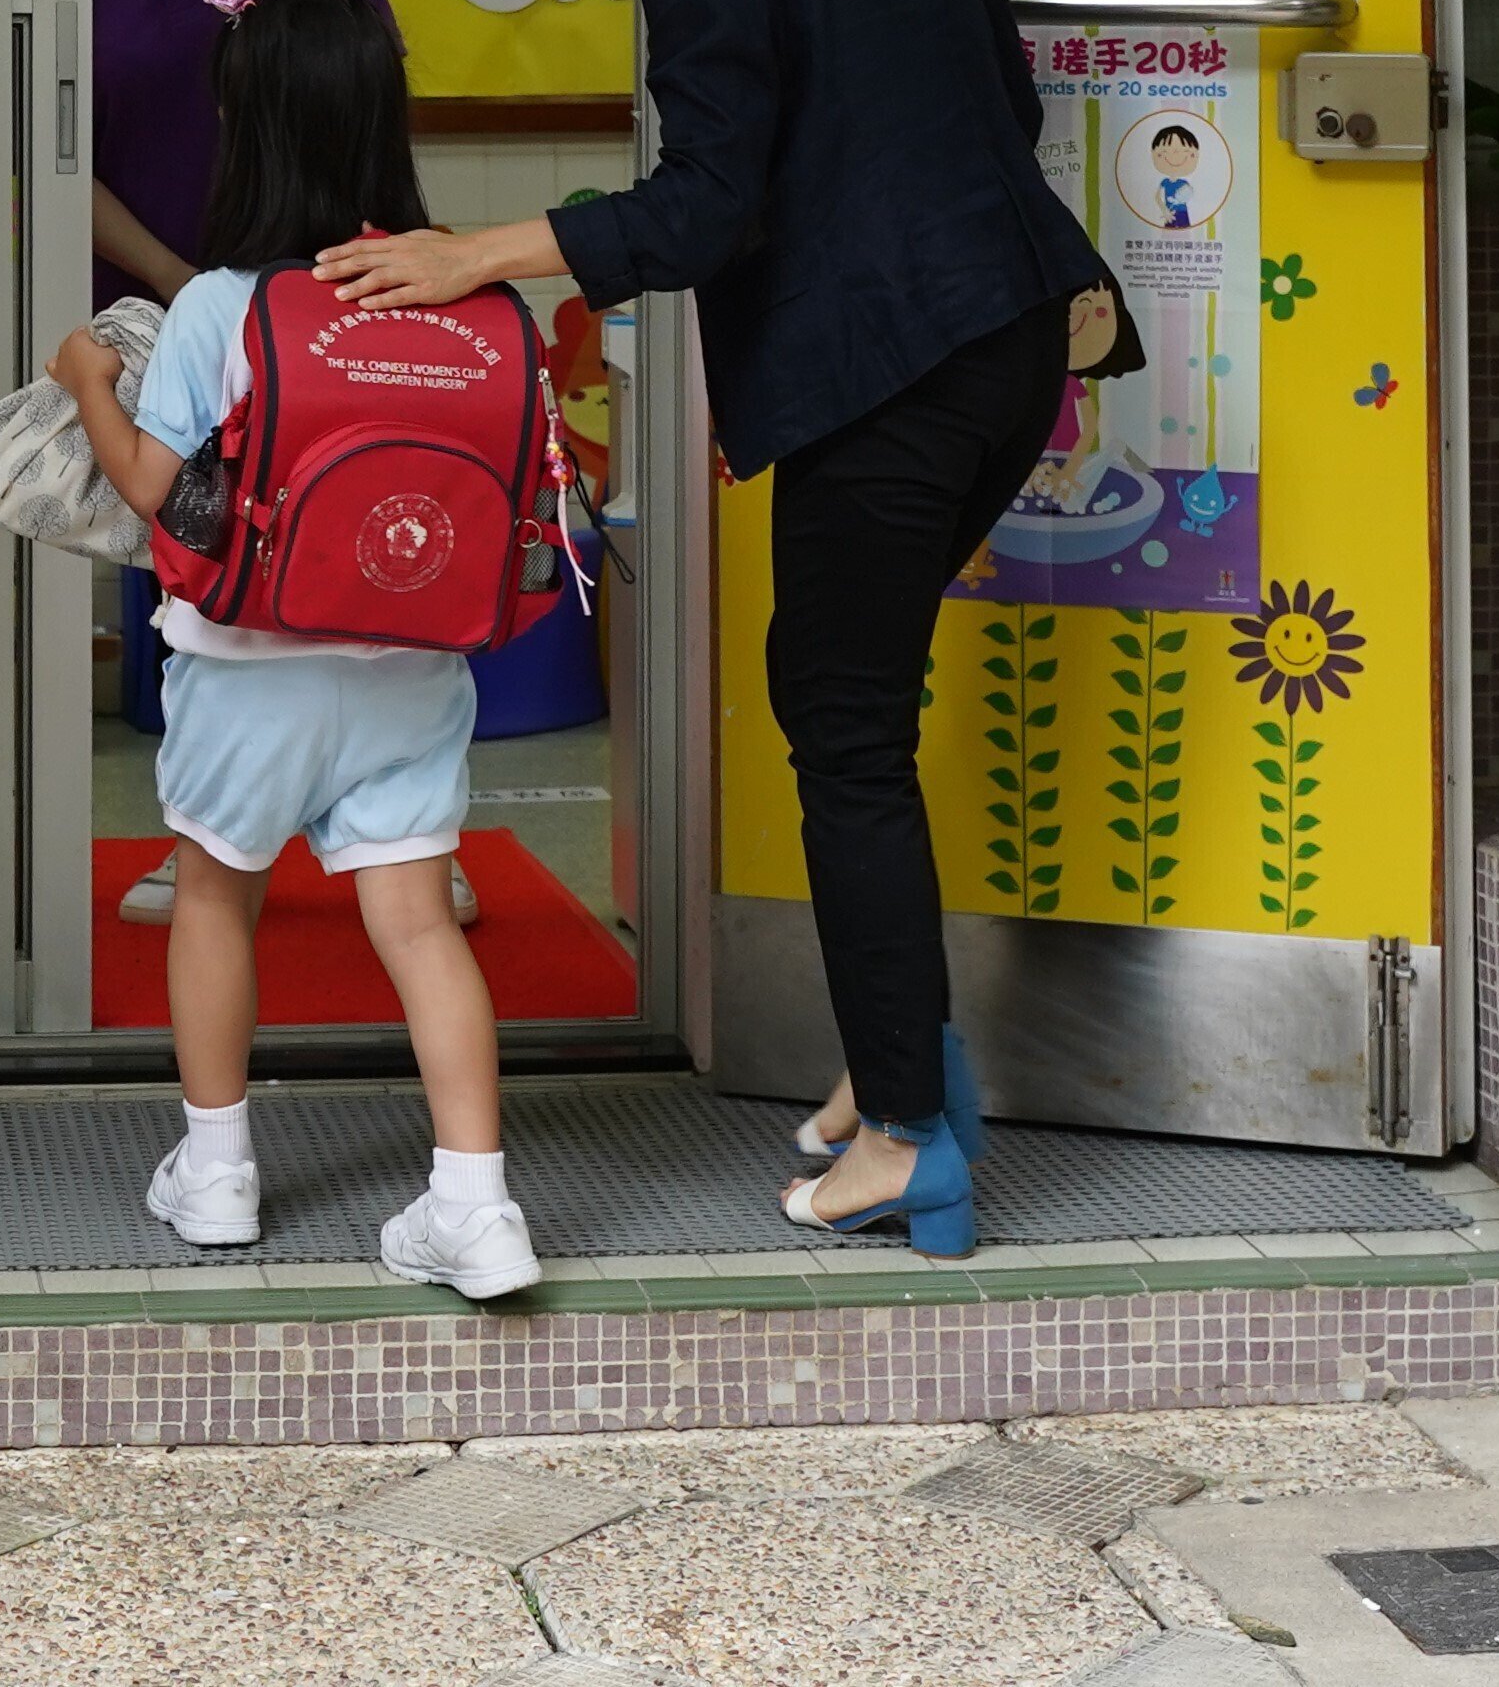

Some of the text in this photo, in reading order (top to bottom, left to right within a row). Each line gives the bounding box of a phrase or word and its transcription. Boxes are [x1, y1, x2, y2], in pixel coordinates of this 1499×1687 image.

[1052, 38, 1228, 76] 搓手20秒
[1082, 80, 1111, 96] for
[1118, 81, 1141, 96] 20
[1148, 81, 1227, 97] seconds
[1068, 162, 1081, 172] to
[326, 358, 345, 369] THE
[369, 361, 409, 373] CHINESE
[462, 368, 487, 380] CLUB
[347, 371, 468, 390] KINDERGARTEN NURSERY
